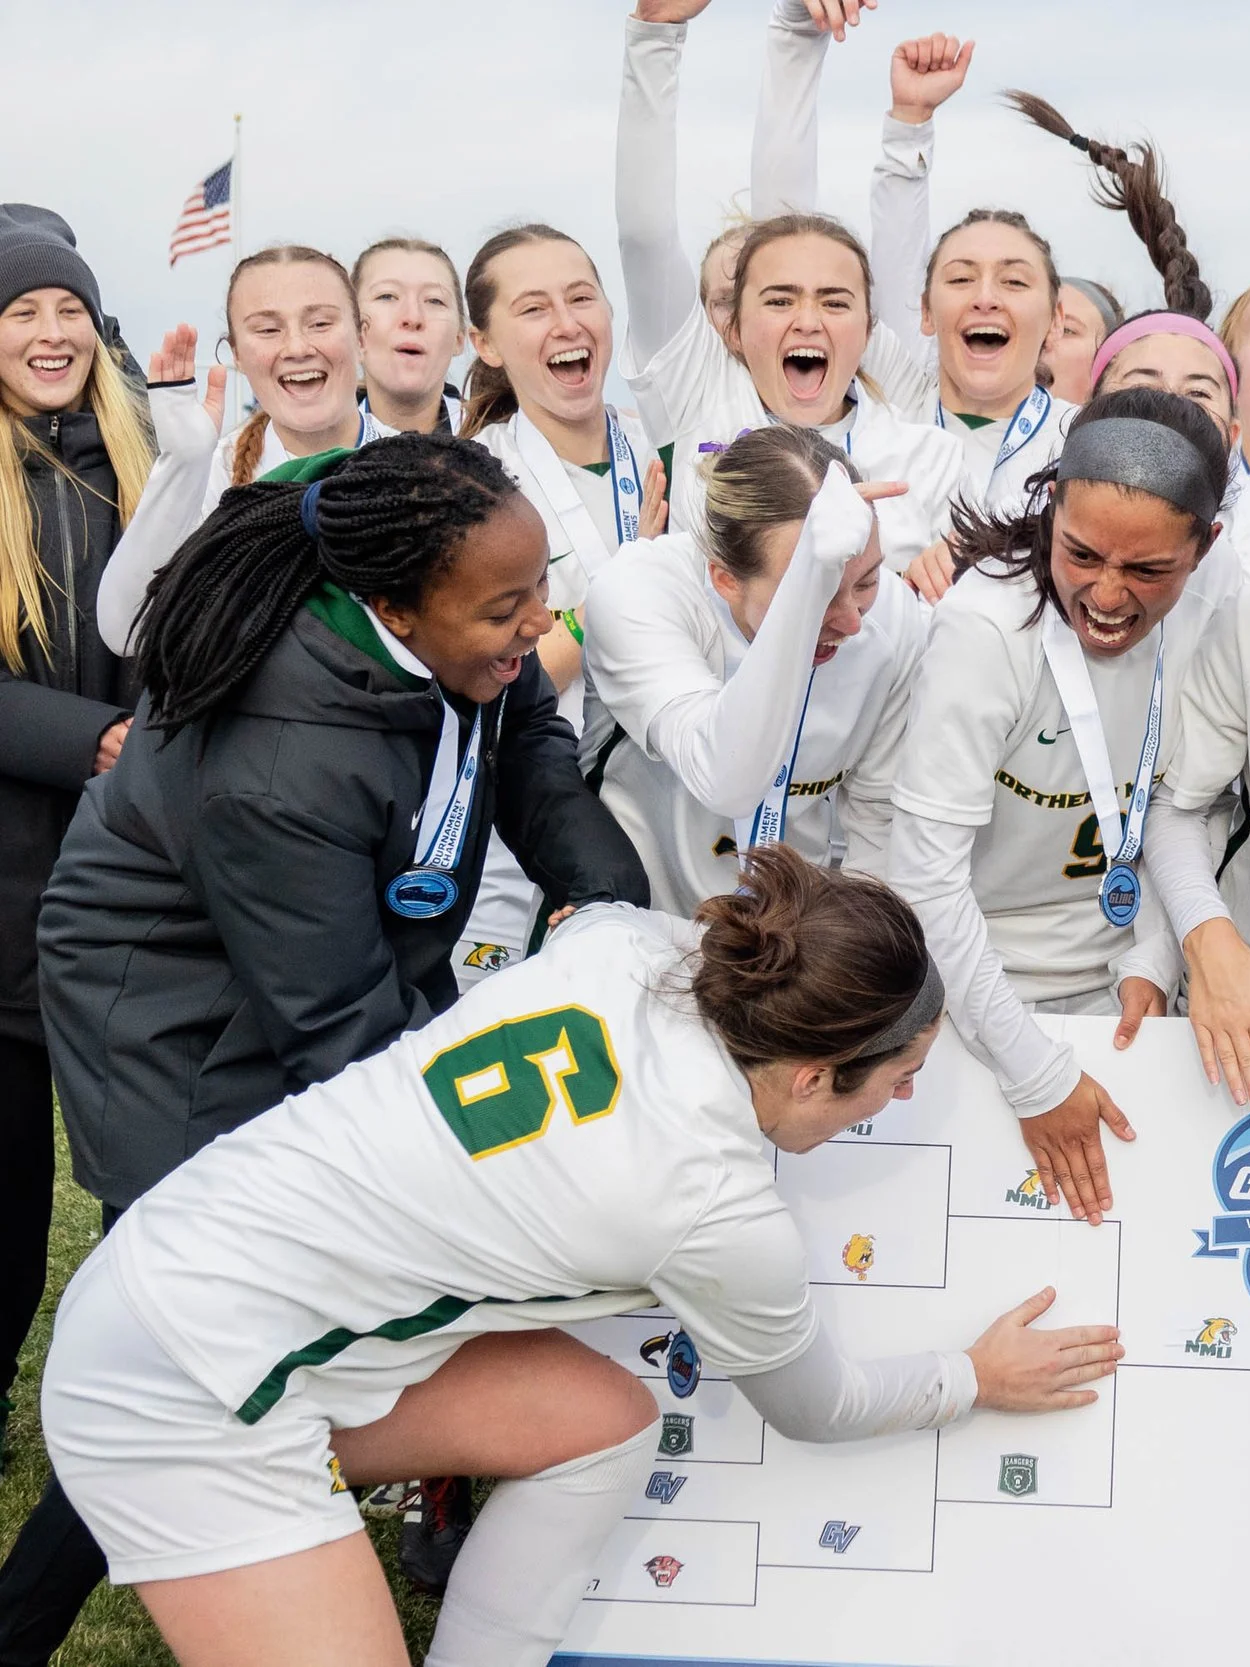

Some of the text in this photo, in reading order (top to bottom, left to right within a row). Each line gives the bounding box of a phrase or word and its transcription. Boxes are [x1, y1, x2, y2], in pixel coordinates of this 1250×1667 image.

[623, 509, 632, 541] AMENT
[431, 799, 462, 868] TOURNAMENT
[440, 806, 465, 868] CHAMPIONS
[760, 805, 772, 845] AMENT
[768, 811, 779, 845] PIONS
[421, 1003, 624, 1162] 6
[1185, 1339, 1232, 1359] NMU
[663, 1417, 690, 1427] ANGERS
[1004, 1457, 1034, 1467] RANGERS
[645, 1471, 688, 1504] GV
[818, 1520, 861, 1553] GV
